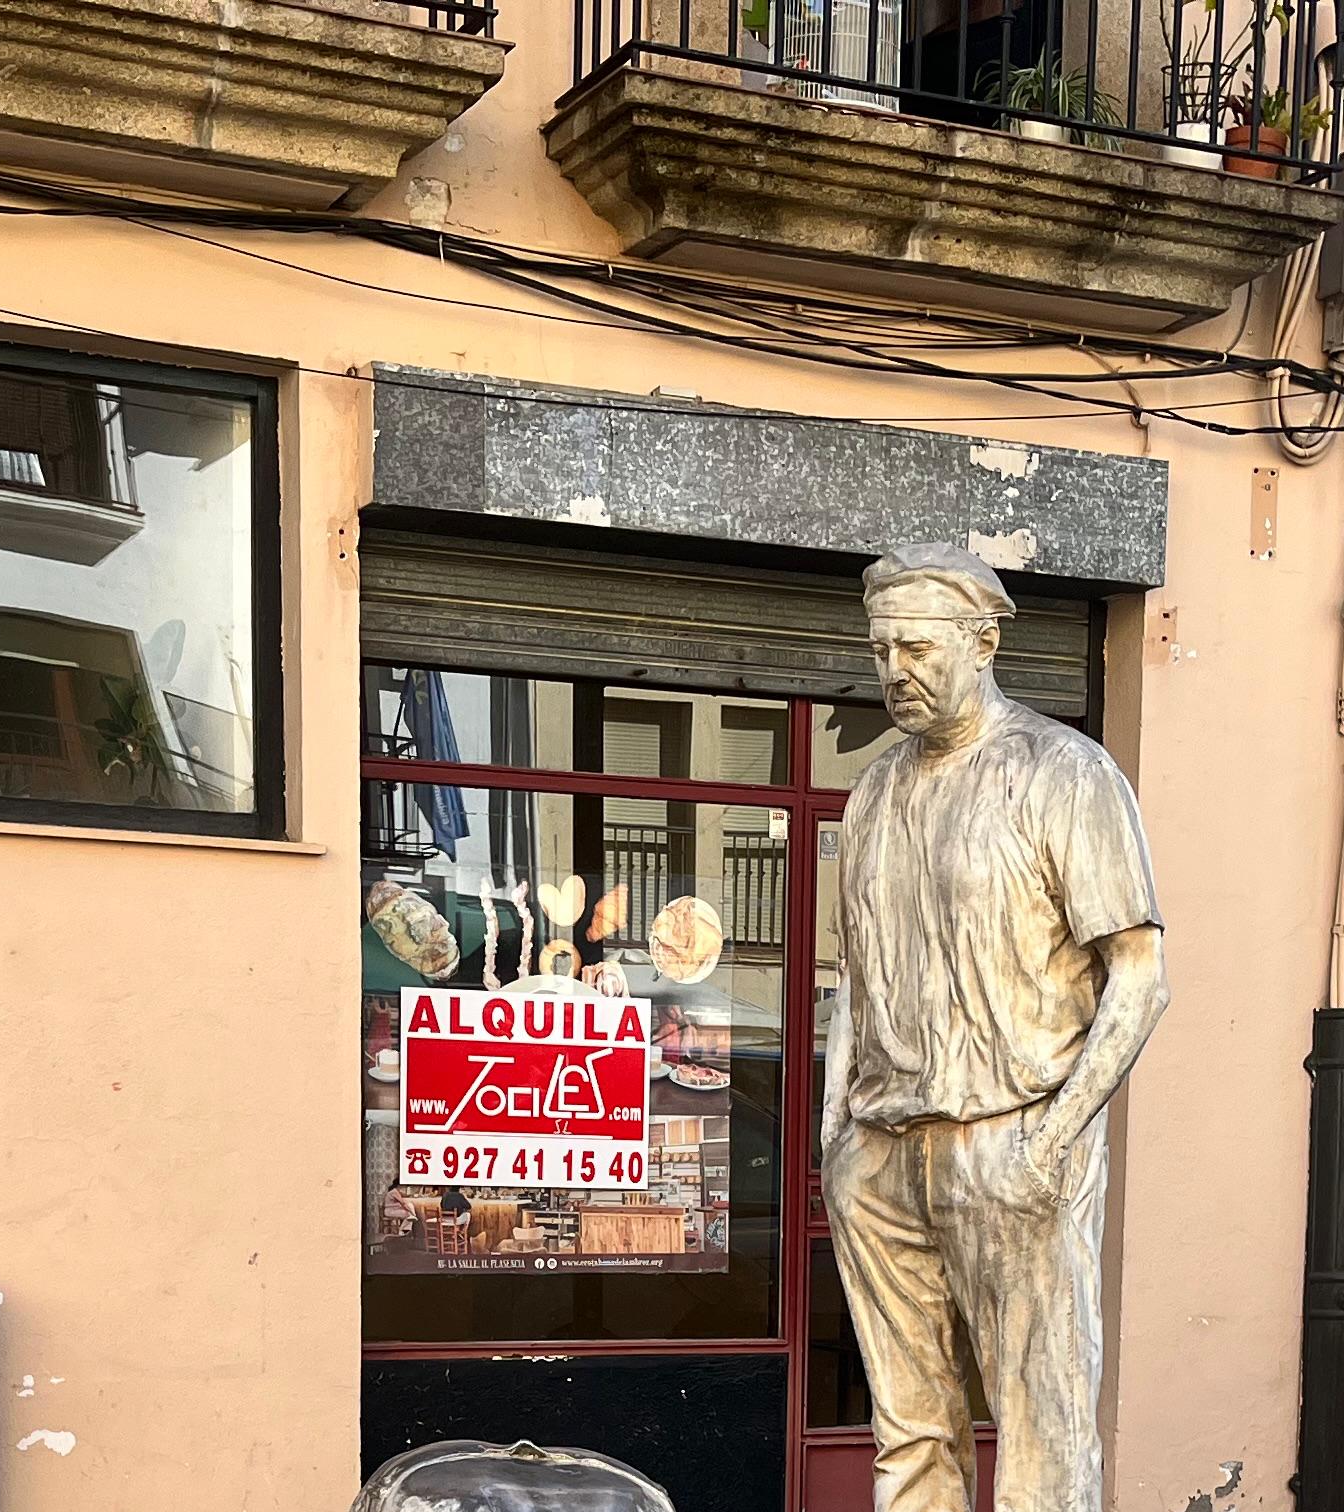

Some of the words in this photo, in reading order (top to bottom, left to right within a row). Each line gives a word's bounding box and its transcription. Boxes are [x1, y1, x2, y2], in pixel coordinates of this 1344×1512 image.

[408, 995, 645, 1042] ALQUILA
[410, 1099, 449, 1115] www.
[609, 1106, 642, 1121] .com
[443, 1146, 498, 1179] 927
[512, 1149, 543, 1180] 41
[563, 1149, 595, 1182] 15
[609, 1151, 643, 1183] 40
